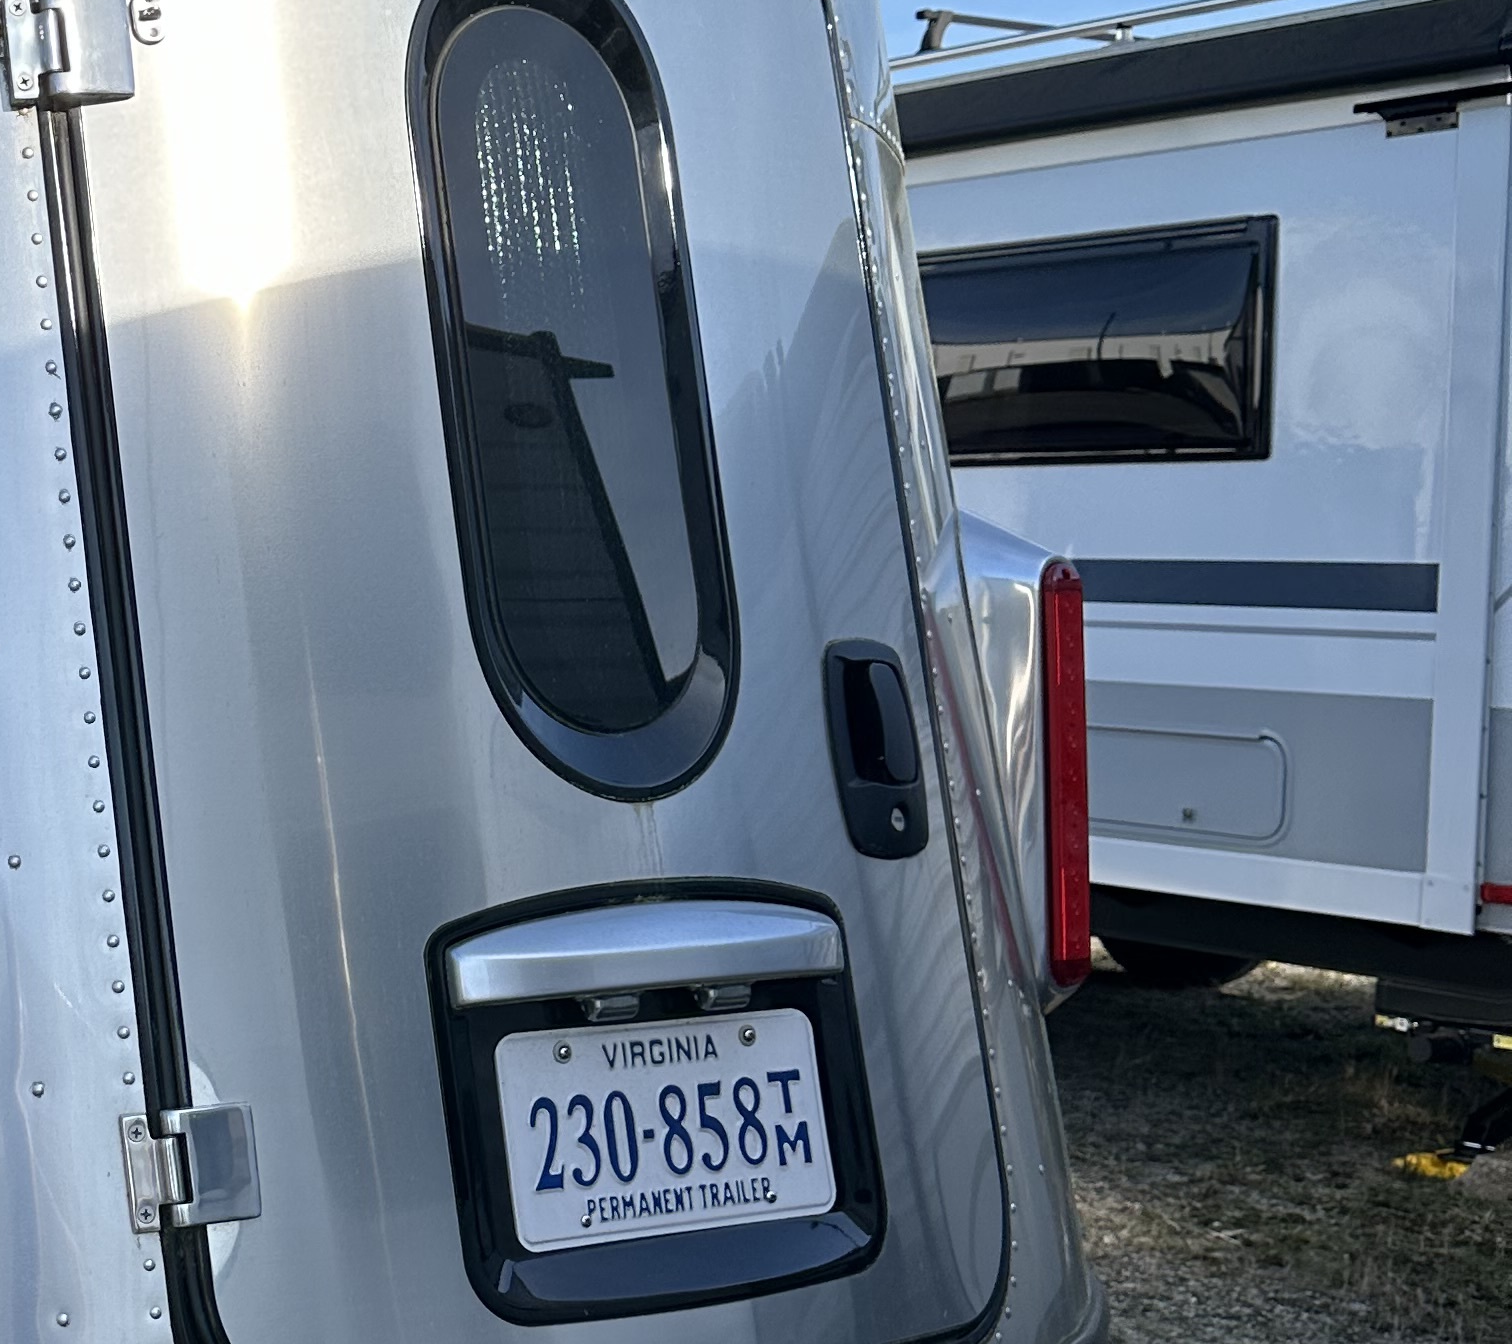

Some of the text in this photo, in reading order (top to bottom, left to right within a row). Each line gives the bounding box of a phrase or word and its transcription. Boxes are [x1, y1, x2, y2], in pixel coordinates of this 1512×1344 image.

[601, 1033, 719, 1070] VIRGINIA
[529, 1076, 768, 1193] 230-858
[586, 1176, 771, 1223] PERMANENT TRAILER
